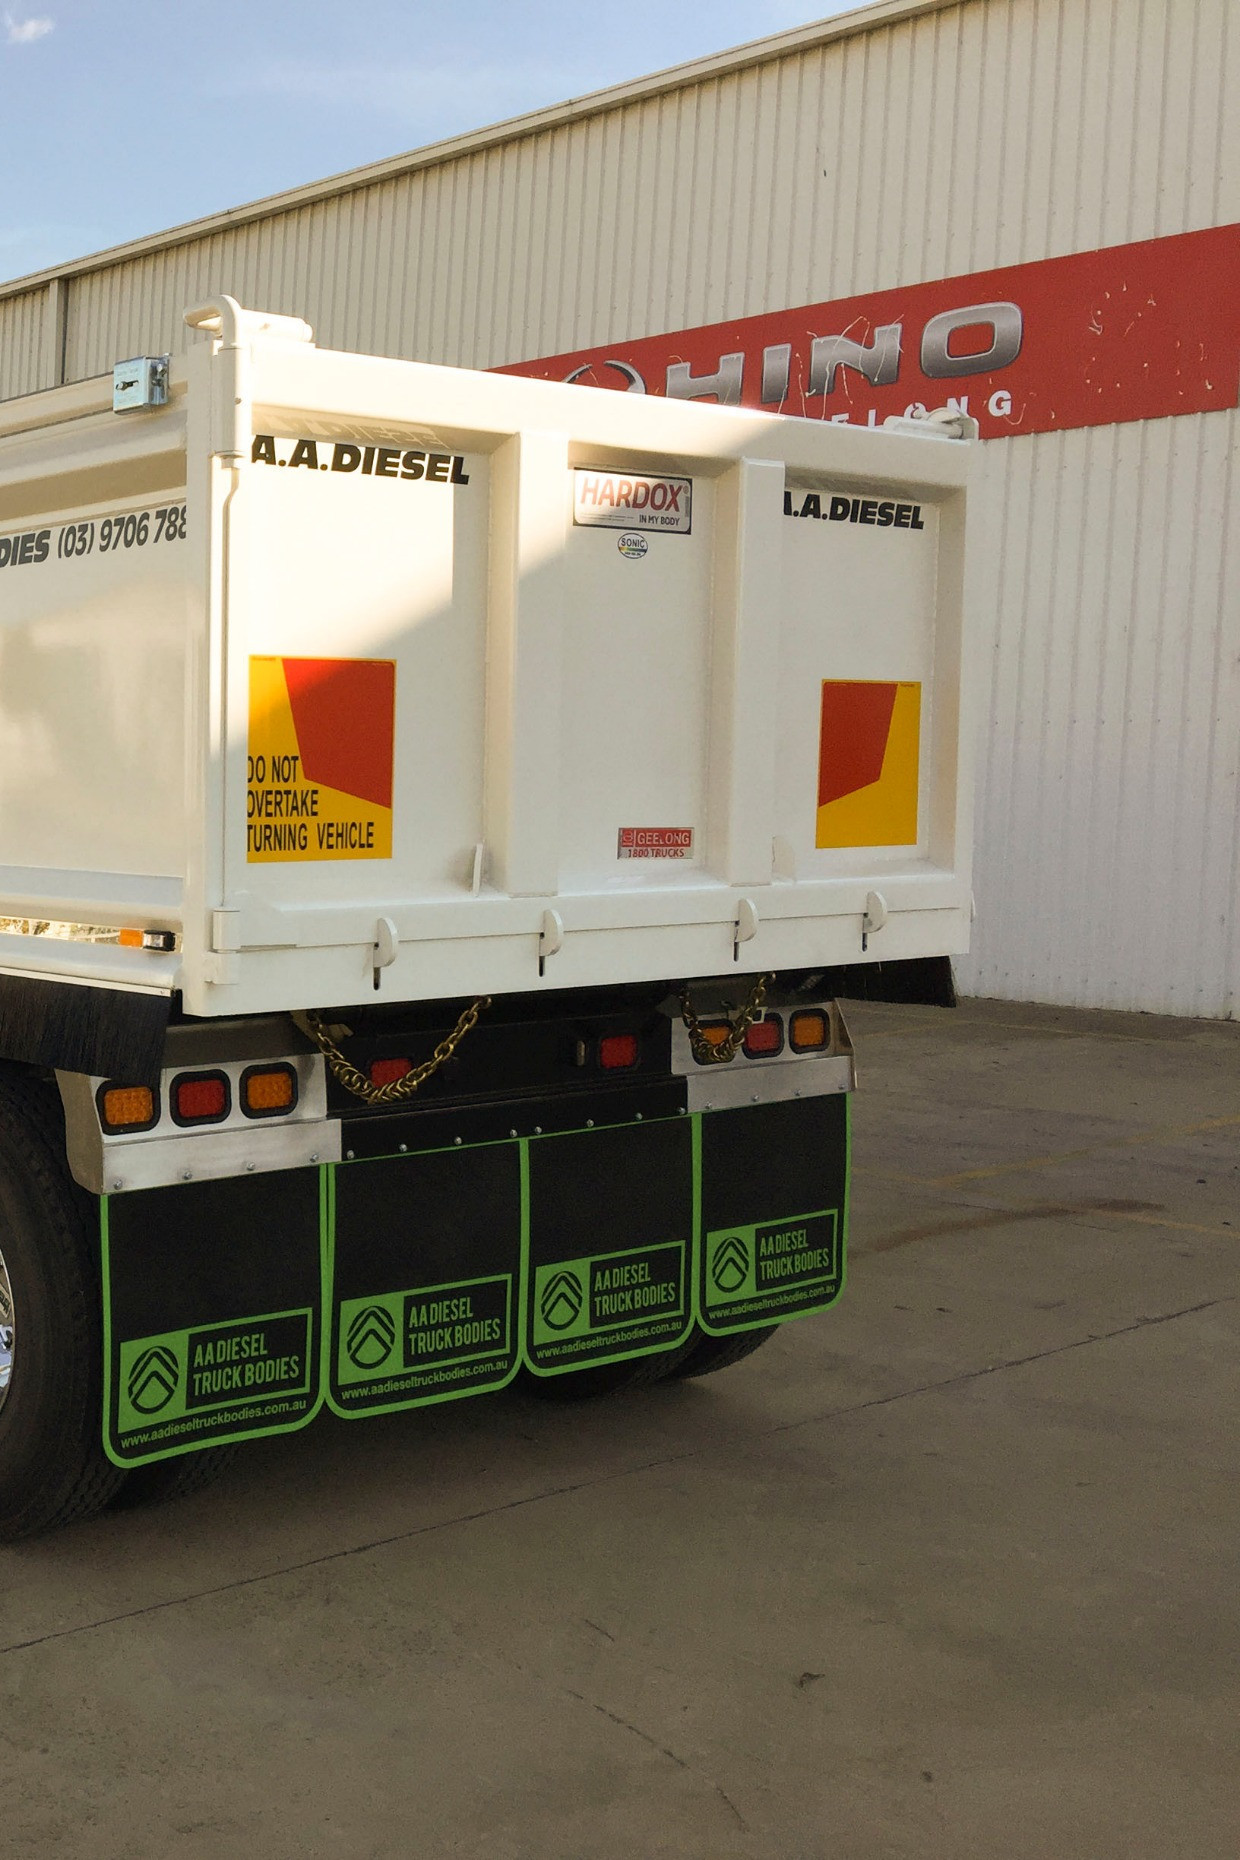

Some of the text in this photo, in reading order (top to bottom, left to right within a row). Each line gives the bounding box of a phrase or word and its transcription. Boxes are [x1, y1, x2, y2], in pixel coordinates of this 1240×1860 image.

[666, 302, 1023, 406] HINO
[251, 434, 469, 485] A.A.DIESEL
[581, 478, 682, 512] HARDOX
[58, 522, 95, 559] (03)
[99, 512, 150, 552] 9706
[639, 515, 647, 523] IN
[648, 515, 660, 524] MY
[660, 516, 680, 526] BODY
[621, 538, 645, 549] SONIC
[272, 755, 299, 783] NOT
[247, 790, 318, 818] OVERTAKE
[247, 822, 374, 852] TURNING VEHICLE
[628, 848, 684, 857] 1800 TRUCKS
[637, 832, 689, 845] GEELONG
[775, 1229, 808, 1253] DIESEL
[612, 1262, 651, 1288] DIESEL
[760, 1248, 829, 1280] TRUCK BODIES
[430, 1297, 473, 1325] DIESEL
[594, 1282, 676, 1317] TRUCK BODIES
[216, 1333, 268, 1364] DIESEL
[409, 1318, 501, 1355] TRUCK BODIES
[536, 1321, 682, 1359] www.aadieseltruckbodies.com.au
[193, 1355, 300, 1396] TRUCK BODIES
[342, 1360, 508, 1400] www.aadieseltruckbodies.com.au
[121, 1400, 307, 1448] www.aadieseltruckbodies.com.au
